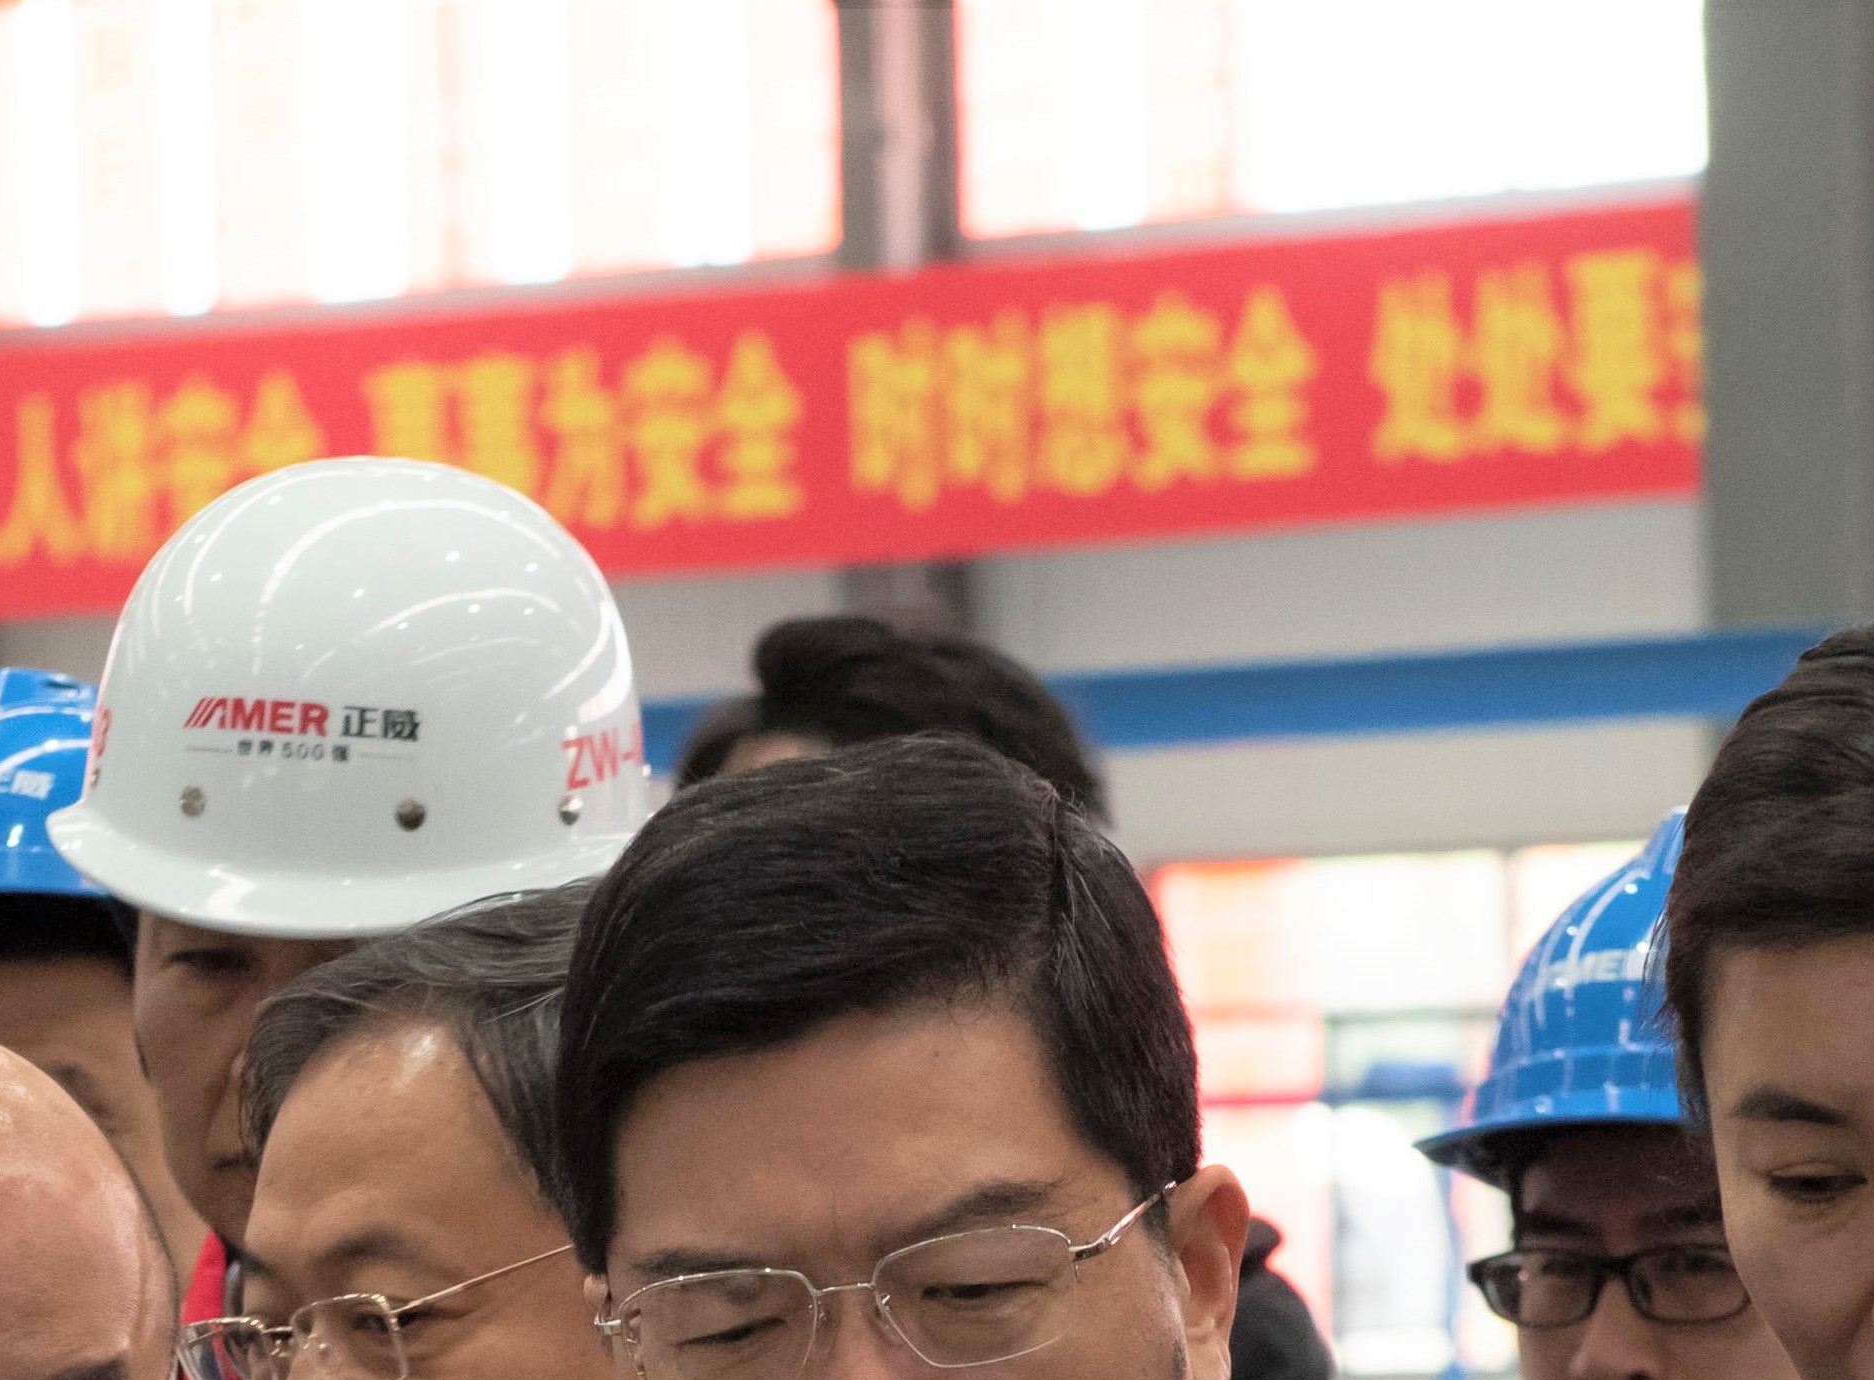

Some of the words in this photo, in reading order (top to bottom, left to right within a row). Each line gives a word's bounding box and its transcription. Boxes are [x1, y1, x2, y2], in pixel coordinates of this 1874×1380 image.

[183, 697, 330, 738] AMER
[339, 705, 420, 742] 正威
[561, 720, 644, 790] ZW-
